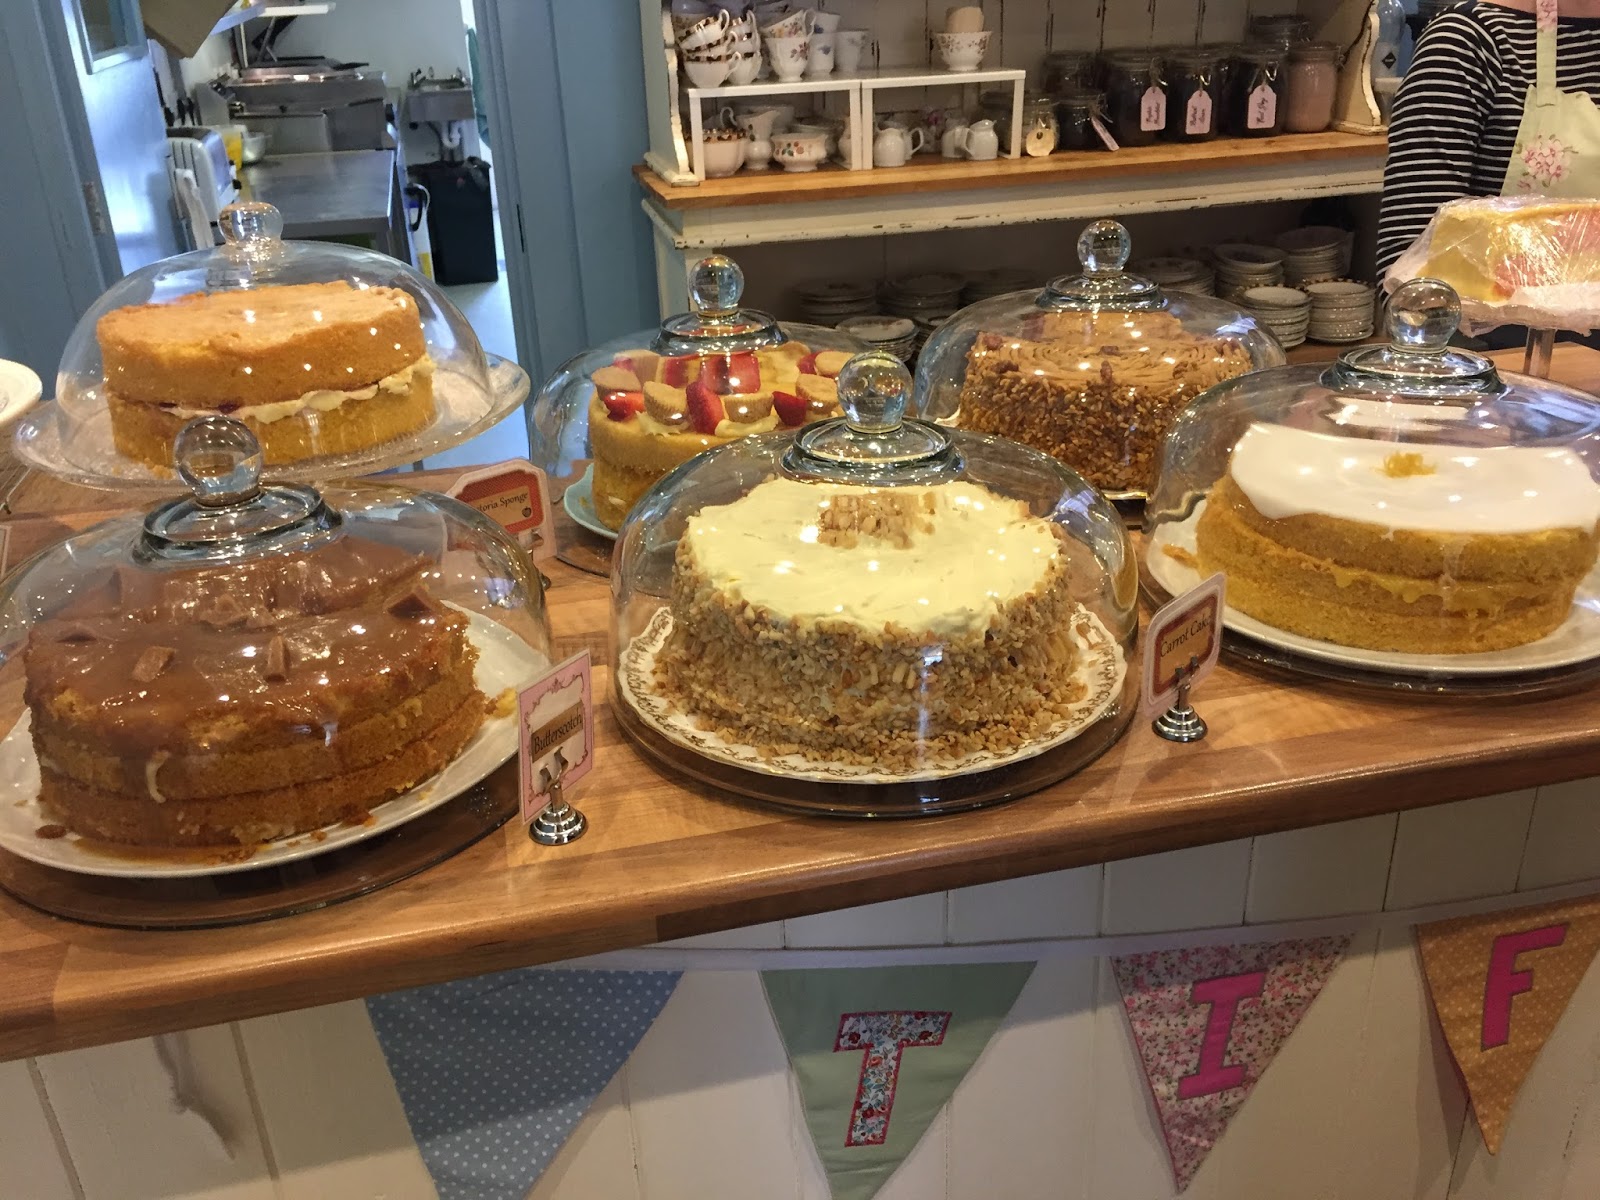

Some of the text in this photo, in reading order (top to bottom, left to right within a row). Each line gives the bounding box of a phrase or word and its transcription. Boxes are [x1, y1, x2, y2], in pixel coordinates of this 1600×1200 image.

[499, 492, 529, 508] Sponge
[1159, 627, 1189, 658] Carrot
[534, 706, 583, 755] Butterscotch
[833, 921, 1571, 1148] T I F
